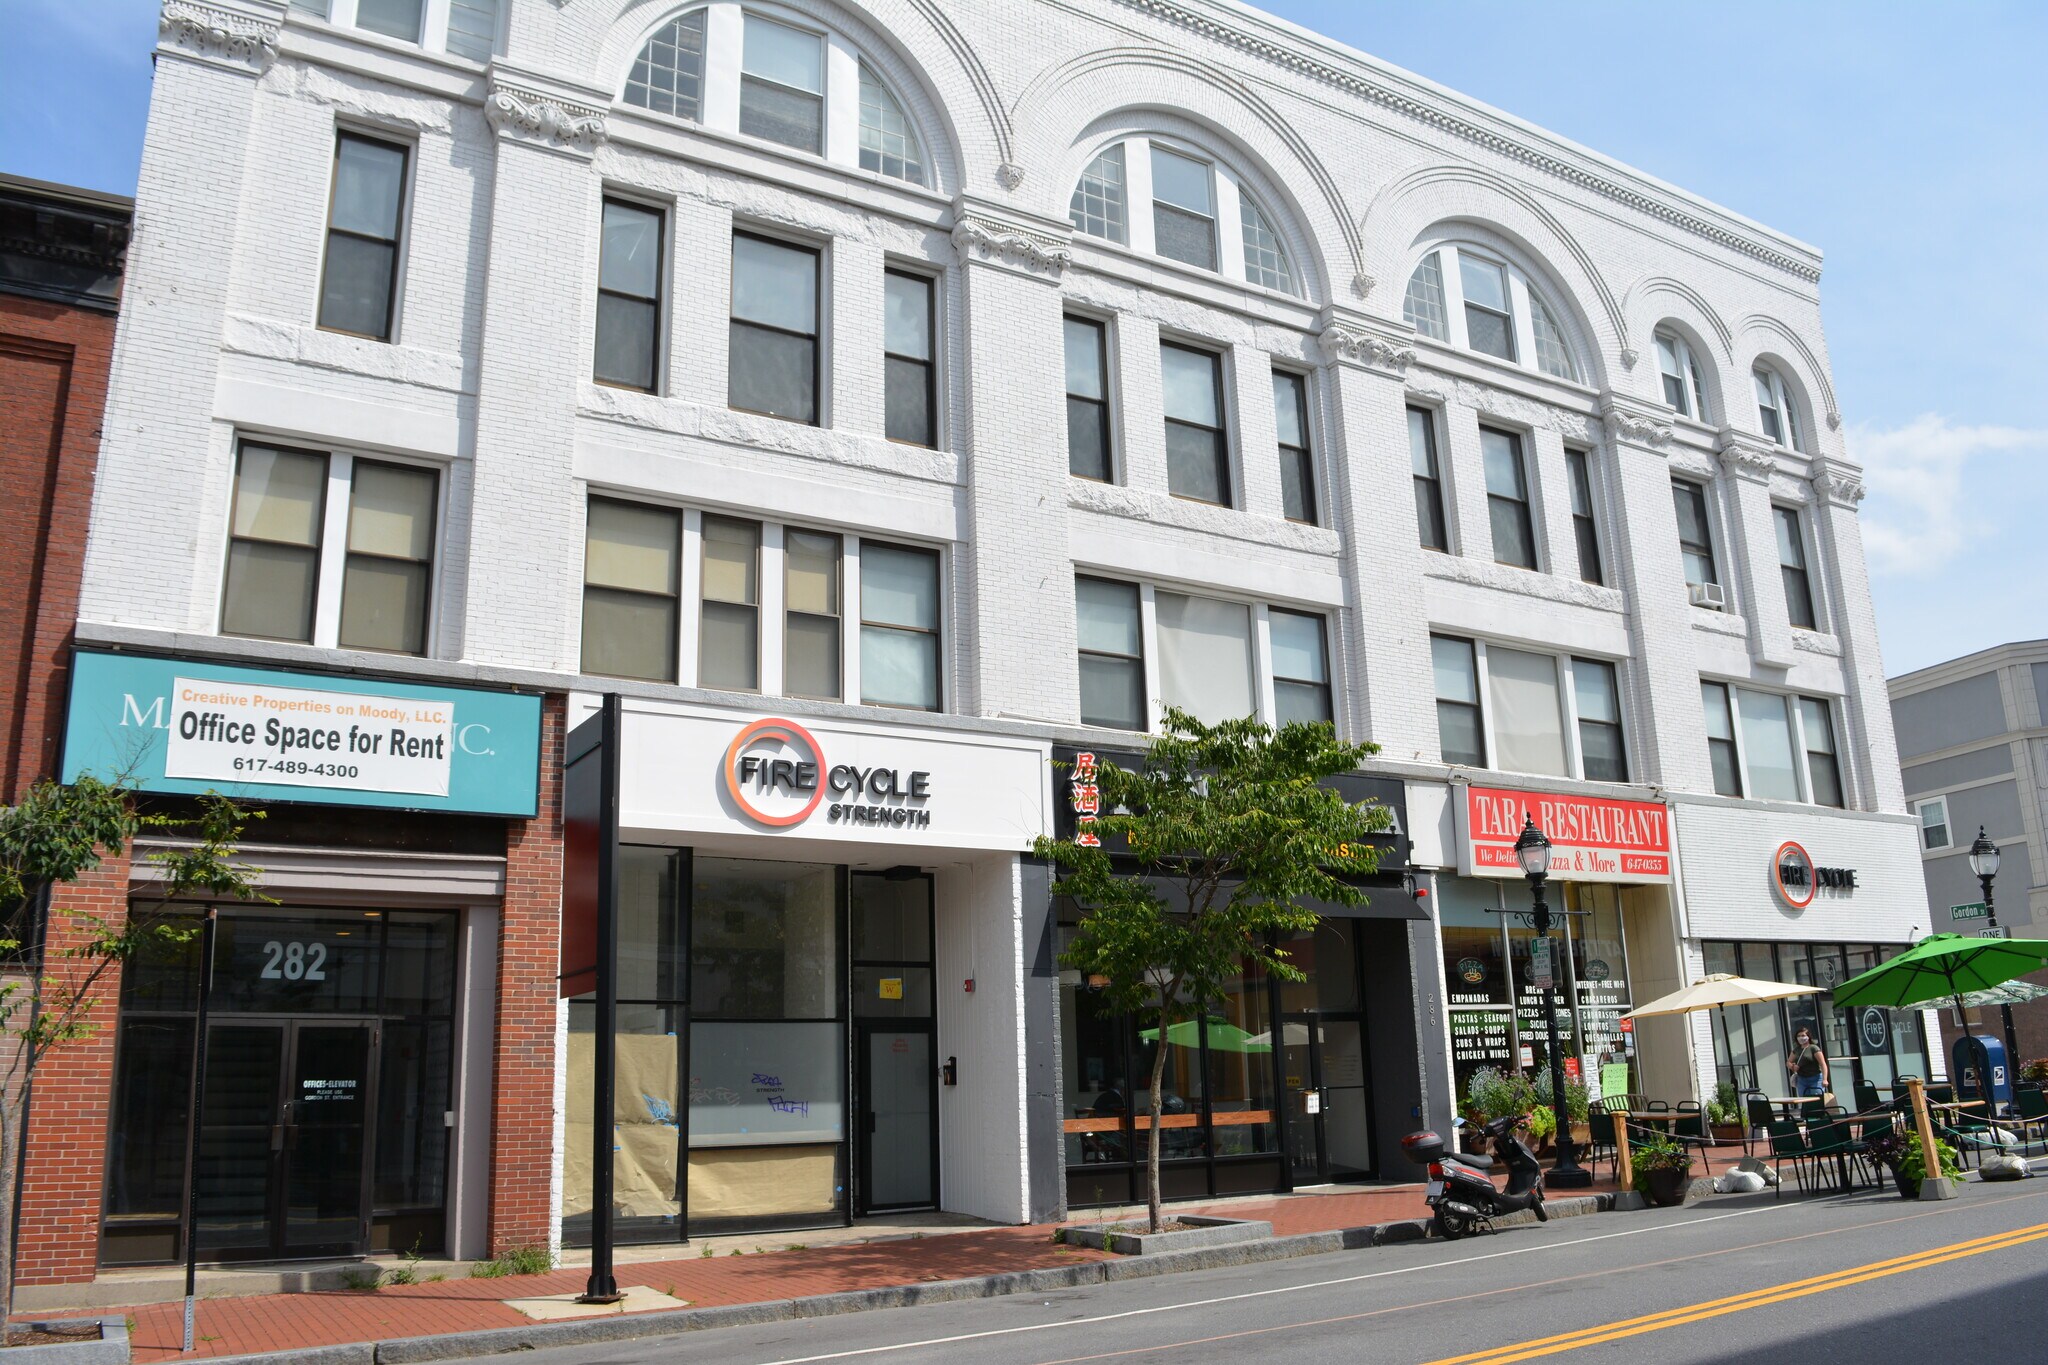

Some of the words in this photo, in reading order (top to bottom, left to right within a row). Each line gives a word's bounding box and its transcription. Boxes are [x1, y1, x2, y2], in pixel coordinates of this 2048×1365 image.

[182, 689, 248, 707] Creative
[253, 695, 331, 713] Properties
[336, 706, 354, 716] on
[359, 704, 410, 723] Moody,
[415, 710, 446, 724] LLC.
[180, 711, 256, 745] Office
[264, 718, 341, 754] Space
[349, 725, 382, 754] for
[390, 728, 444, 760] Rent
[233, 757, 358, 779] 617-489-4300
[740, 756, 817, 790] FIRE
[829, 764, 932, 798] CYCLE
[830, 803, 931, 826] STRENGTH
[1539, 800, 1663, 846] RESTAURANT
[1481, 849, 1493, 862] We
[1574, 851, 1584, 871] &
[1588, 852, 1616, 873] More
[1627, 858, 1662, 871] 647-0355
[1779, 865, 1811, 885] FIRE
[1816, 867, 1859, 888] CYCLE
[1952, 906, 1979, 919] Gordon
[1982, 930, 2002, 939] ONE
[260, 940, 327, 981] 282
[1460, 961, 1483, 972] PIZZA
[1576, 980, 1598, 989] INTERNET
[1602, 980, 1612, 989] FREE
[1613, 980, 1625, 989] WI-FI
[1451, 993, 1490, 1003] EMPANADAS
[1520, 996, 1538, 1005] LUNCH
[1539, 996, 1544, 1005] &
[1428, 993, 1436, 1026] 286
[1517, 1008, 1539, 1018] PIZZAS
[1453, 1014, 1478, 1023] PASTAS
[1455, 1025, 1479, 1035] SALADS
[1485, 1025, 1505, 1034] SOUPS
[1866, 1022, 1883, 1035] FIRE
[1519, 1031, 1534, 1040] FRIED
[1585, 1033, 1624, 1043] QUESADILLAS
[1456, 1038, 1473, 1048] SUBS
[1477, 1037, 1482, 1047] &
[1485, 1037, 1506, 1046] WRAPS
[1456, 1050, 1486, 1060] CHICKEN
[1489, 1049, 1510, 1059] WINGS
[303, 1080, 356, 1088] OFFICES-ELEVATOR
